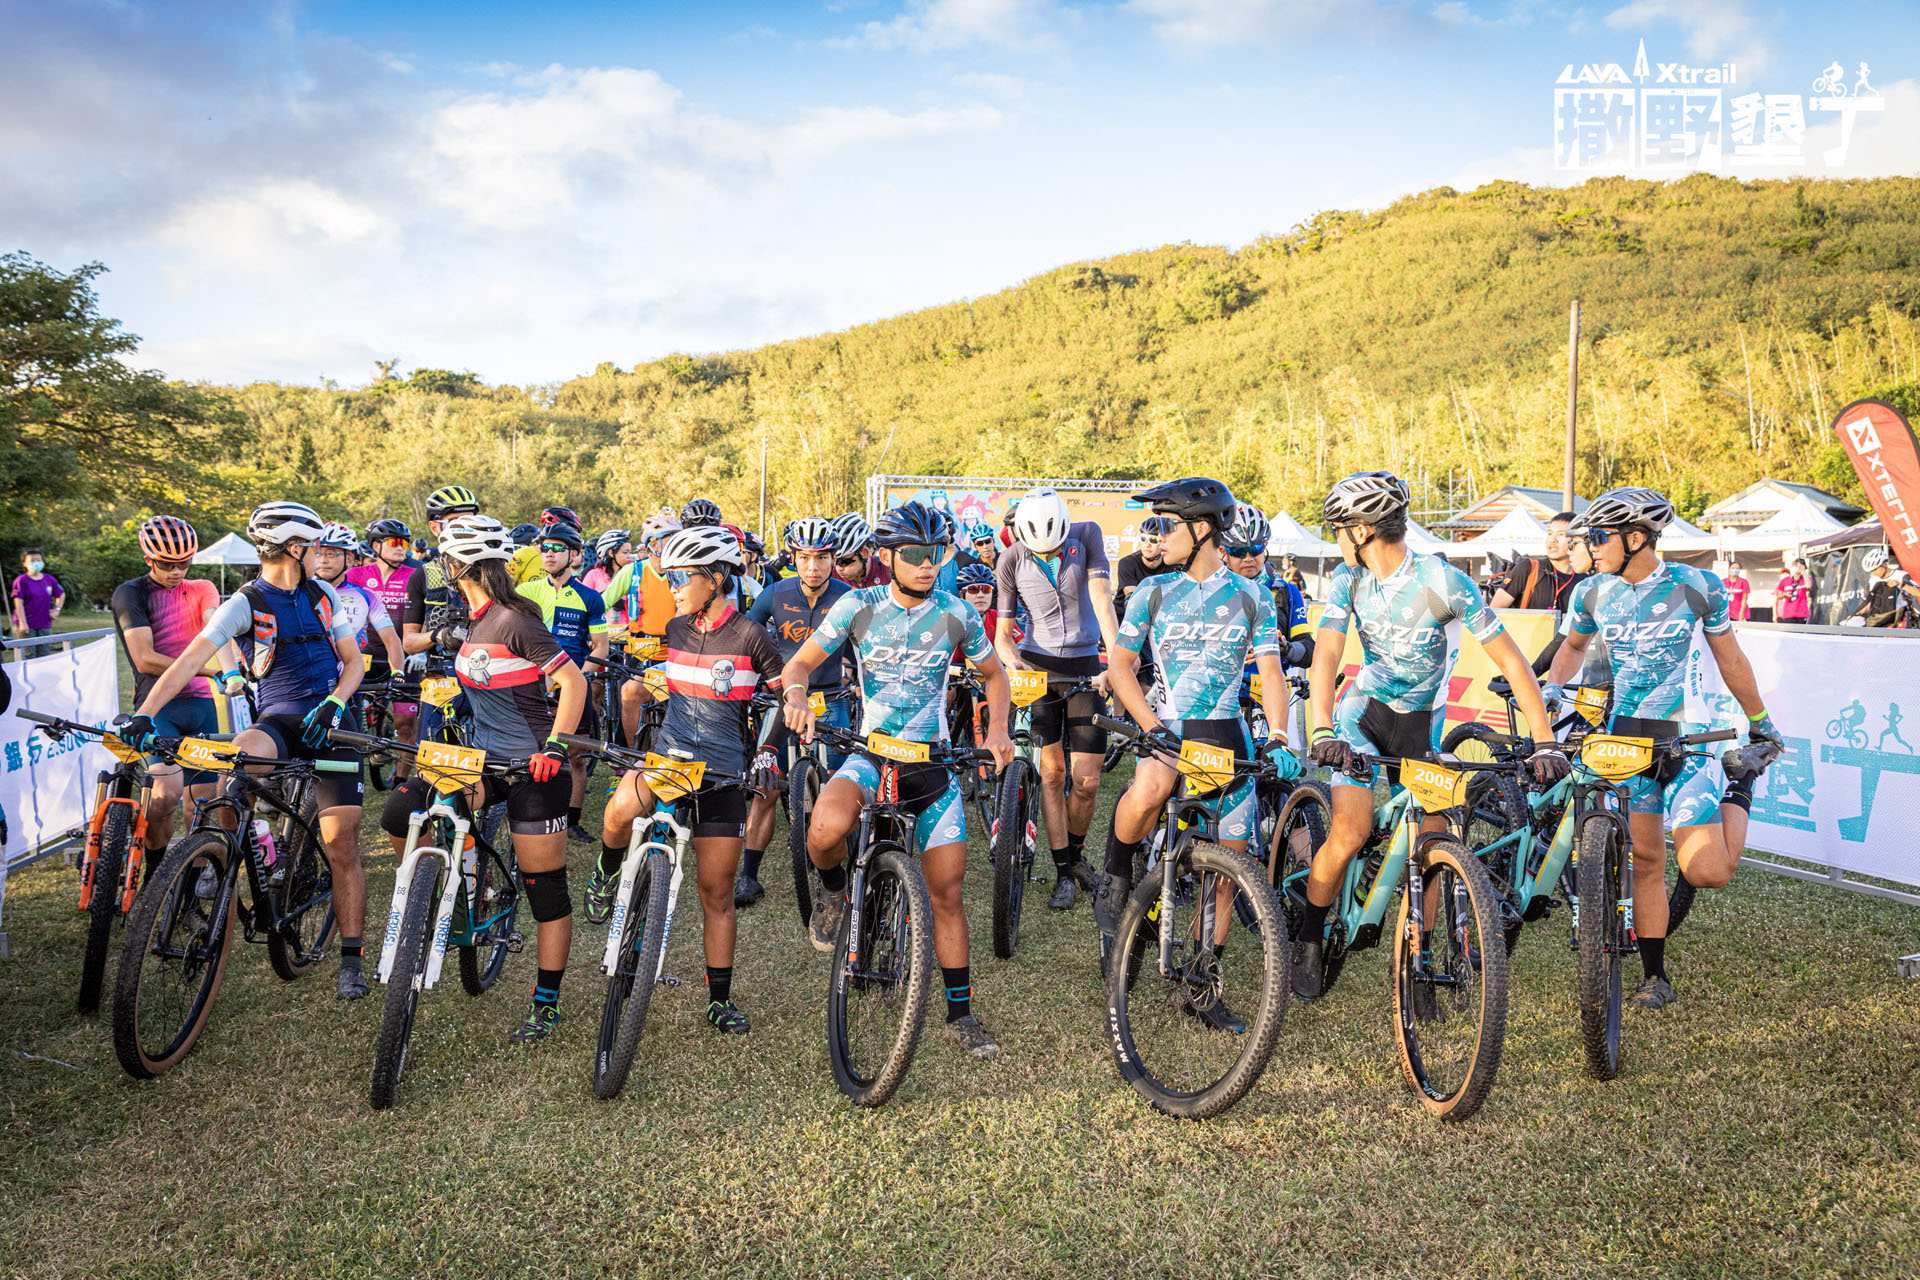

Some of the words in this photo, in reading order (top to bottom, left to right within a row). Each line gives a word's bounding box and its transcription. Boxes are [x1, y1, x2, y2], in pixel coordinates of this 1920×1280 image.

[634, 641, 654, 650] 2077
[652, 674, 666, 684] 21
[1009, 676, 1038, 688] 2019
[880, 743, 918, 759] 2006
[1597, 743, 1639, 758] 2004
[431, 751, 470, 770] 2114
[1191, 751, 1224, 769] 2047
[1415, 768, 1454, 791] 2005
[1109, 1007, 1130, 1064] MAXXIS
